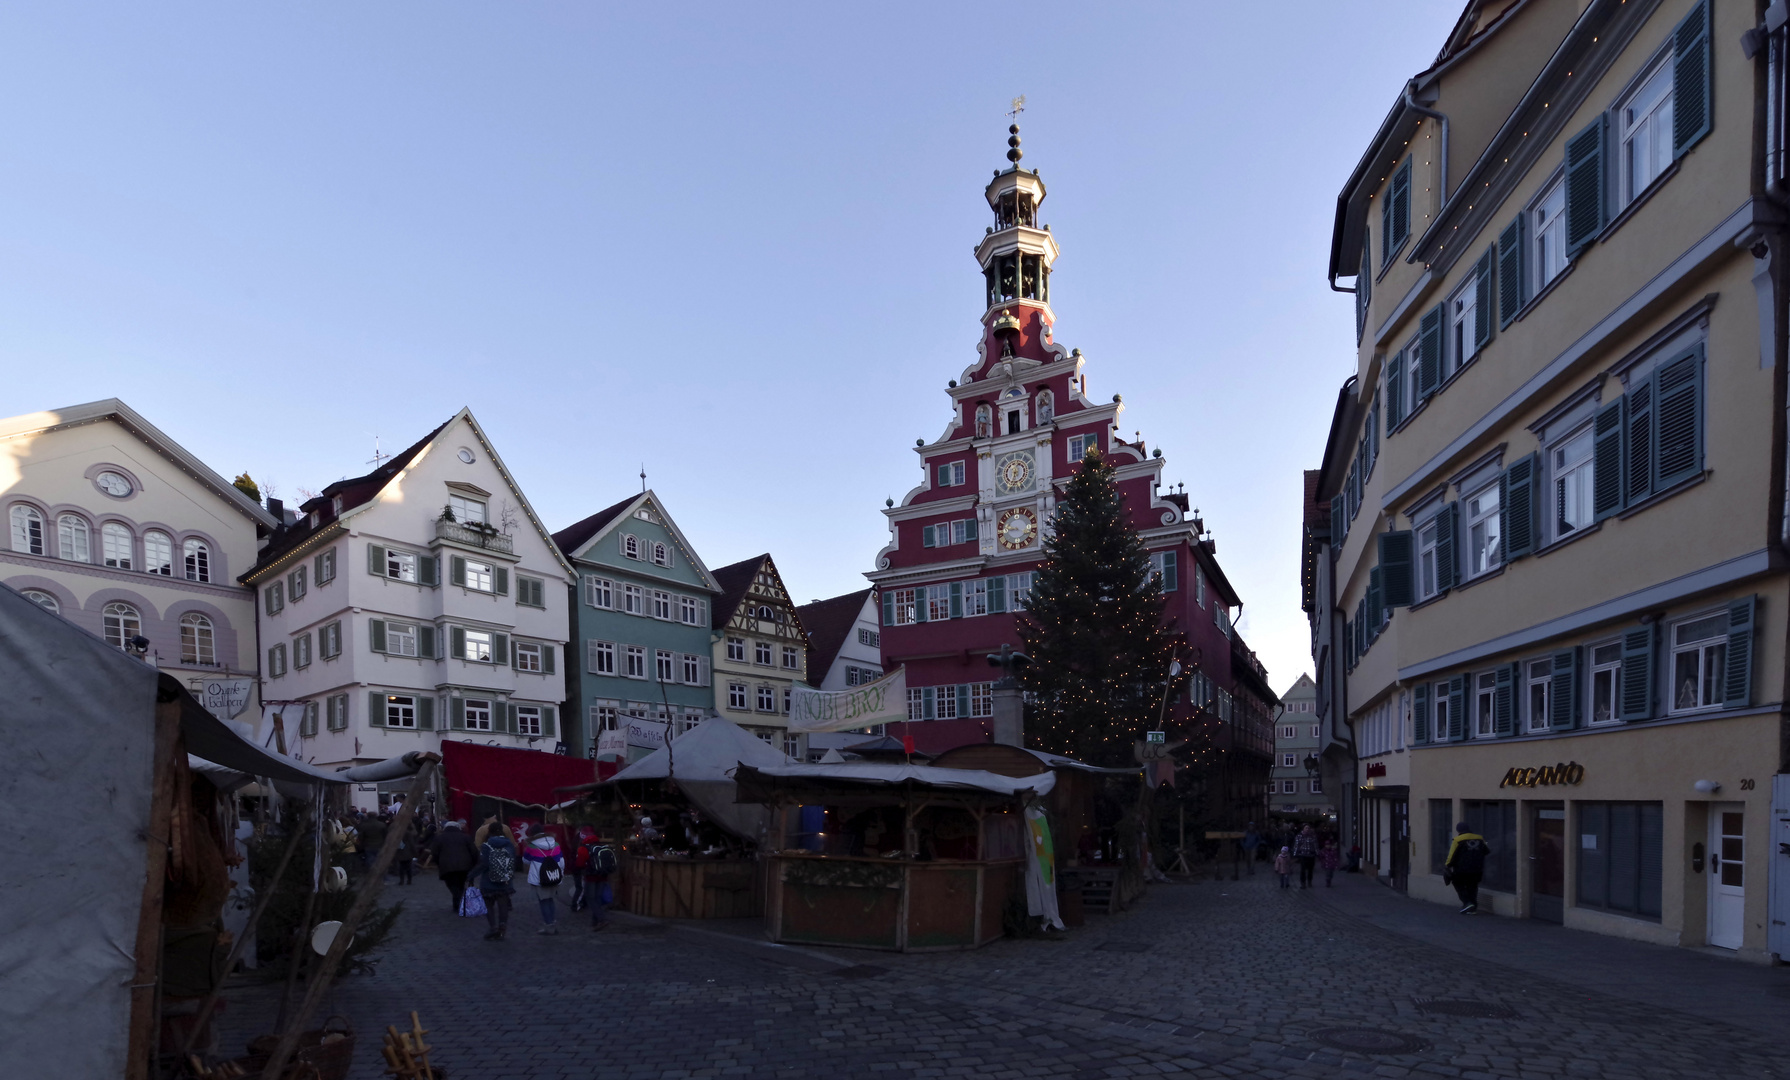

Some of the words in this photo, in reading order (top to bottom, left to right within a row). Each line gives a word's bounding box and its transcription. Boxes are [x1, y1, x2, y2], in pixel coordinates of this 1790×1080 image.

[845, 682, 890, 719] BROT
[1499, 761, 1585, 788] ACCANTO
[1740, 778, 1755, 791] 20
